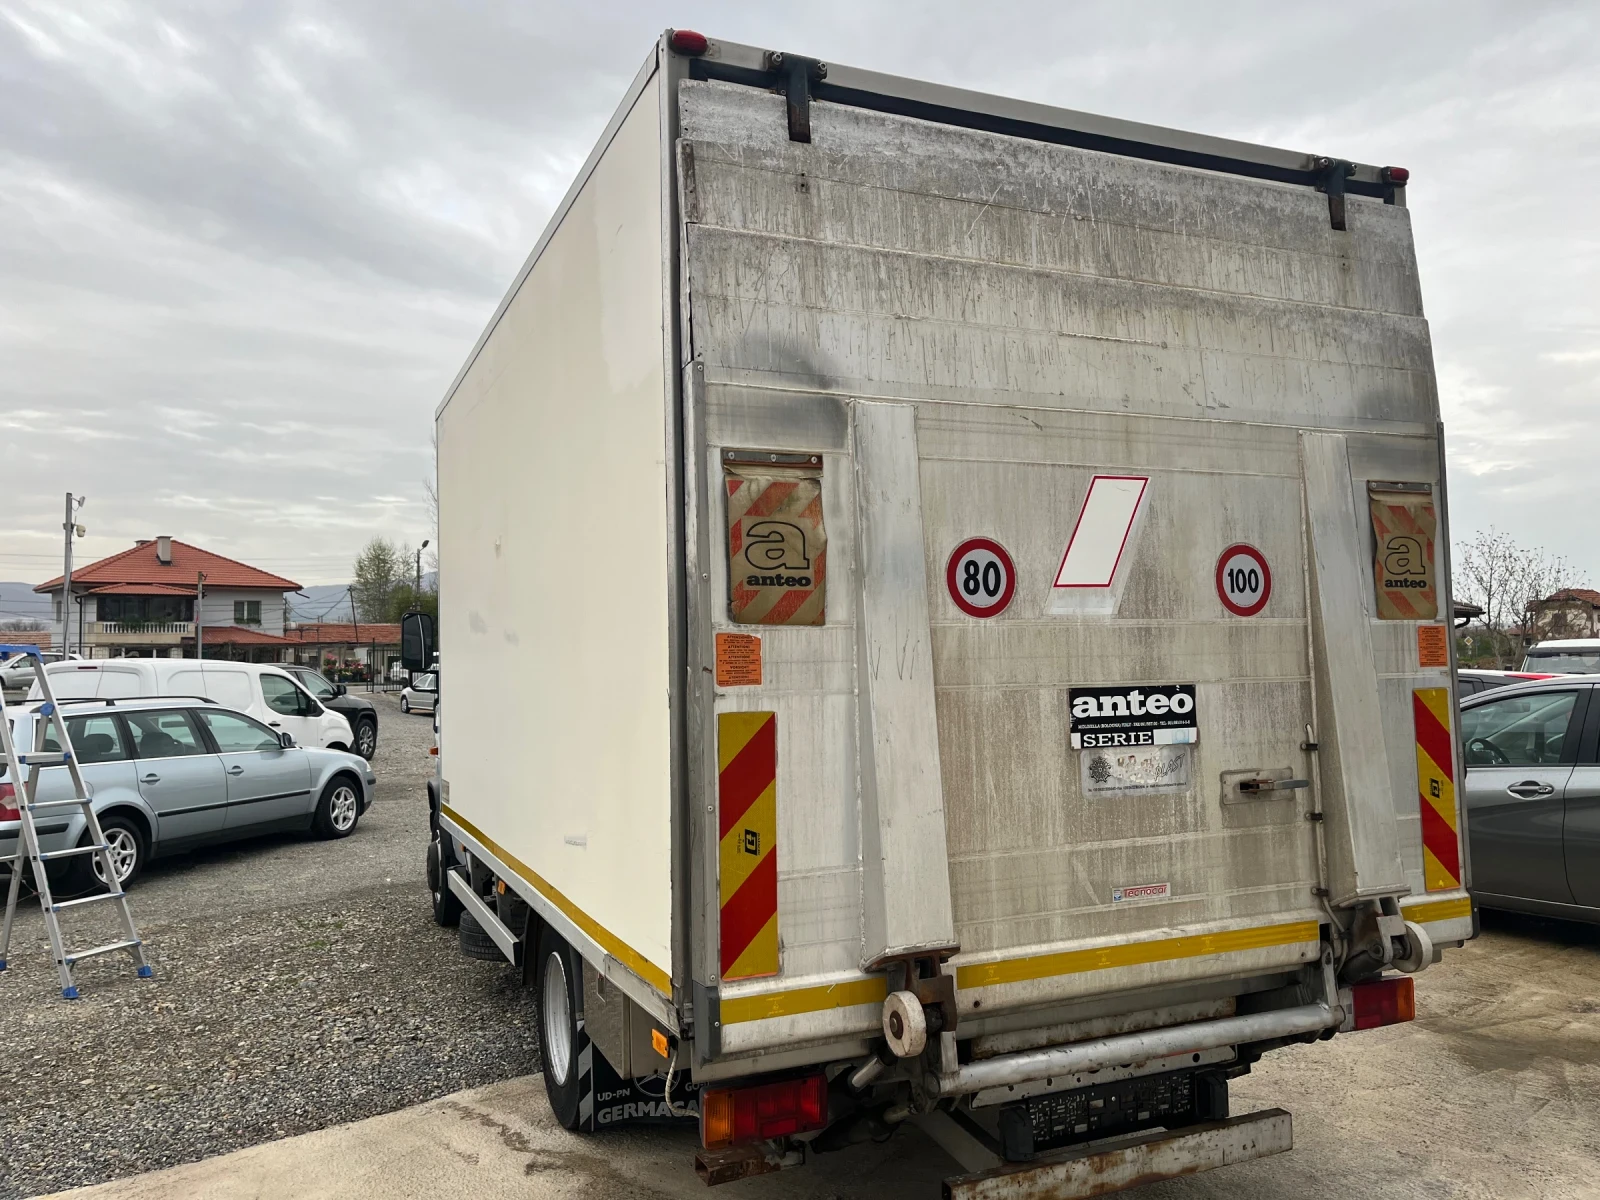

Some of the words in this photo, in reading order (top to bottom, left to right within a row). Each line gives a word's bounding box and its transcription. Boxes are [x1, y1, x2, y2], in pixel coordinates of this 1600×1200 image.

[746, 573, 812, 587] anteo
[962, 559, 1001, 598] 80
[1227, 568, 1260, 594] 100
[1384, 578, 1427, 589] anteo
[1072, 689, 1194, 719] anteo
[1083, 731, 1152, 748] SERIE
[1123, 884, 1167, 898] Tecnocar
[597, 1087, 631, 1102] UD-PN
